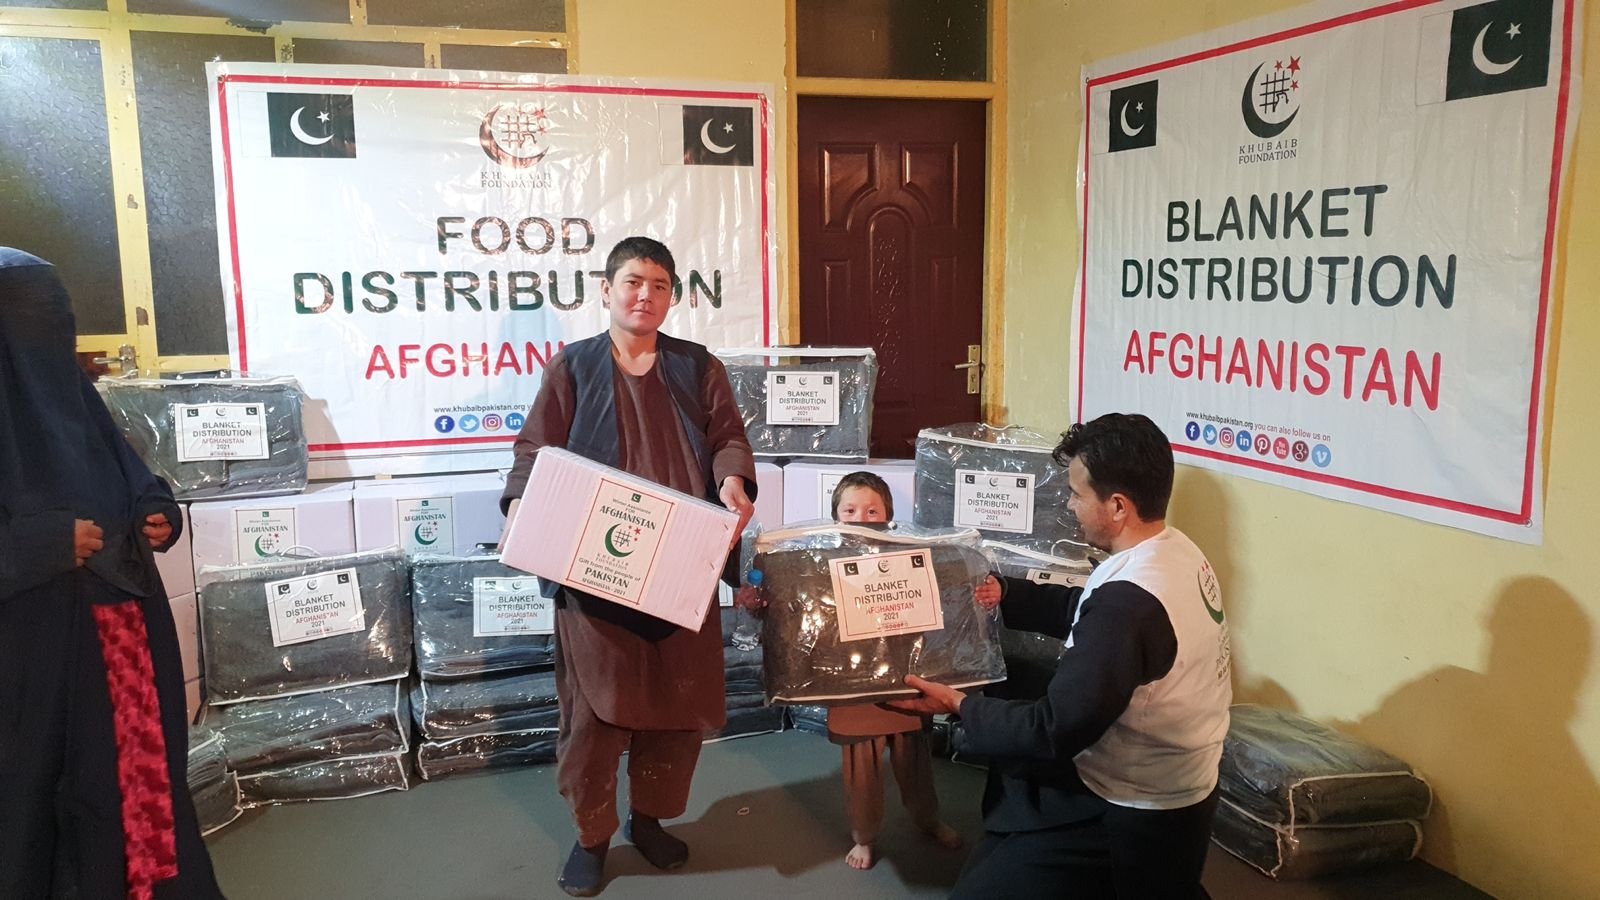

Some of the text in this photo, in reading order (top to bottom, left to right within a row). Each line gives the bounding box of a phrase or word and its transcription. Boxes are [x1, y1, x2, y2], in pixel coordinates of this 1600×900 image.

[1239, 138, 1298, 155] KHUBAIB
[1238, 149, 1297, 165] FOUNDATION
[1167, 184, 1388, 243] BLANKET
[437, 216, 595, 256] FOOD
[1122, 254, 1457, 309] DISTRIBUTION
[294, 269, 722, 314] DISTRIBUN
[1123, 329, 1442, 411] AFGHANISTAN
[434, 405, 525, 413] www.khubaibpakistan.org
[1254, 423, 1265, 431] you
[1279, 426, 1291, 435] also
[1292, 428, 1311, 439] follow
[1322, 434, 1331, 442] on
[968, 499, 1019, 509] DISTRIBUTION
[977, 492, 1010, 500] BLANKET
[600, 505, 656, 530] AFGHANISTAN
[974, 508, 1011, 516] AFGHANISTAN
[243, 525, 288, 533] AFGHANISTAN
[578, 557, 590, 565] Gift
[589, 561, 605, 570] from
[613, 569, 634, 581] people
[584, 567, 629, 588] PAKISTAN
[864, 580, 908, 593] BLANKET
[294, 594, 333, 607] BLANKET
[489, 603, 544, 611] DISTRIBUTION
[499, 595, 535, 603] BLANKET
[286, 601, 346, 618] DISTRIBUTION
[866, 602, 914, 615] AFGHANISTAN
[884, 612, 899, 620] 2021
